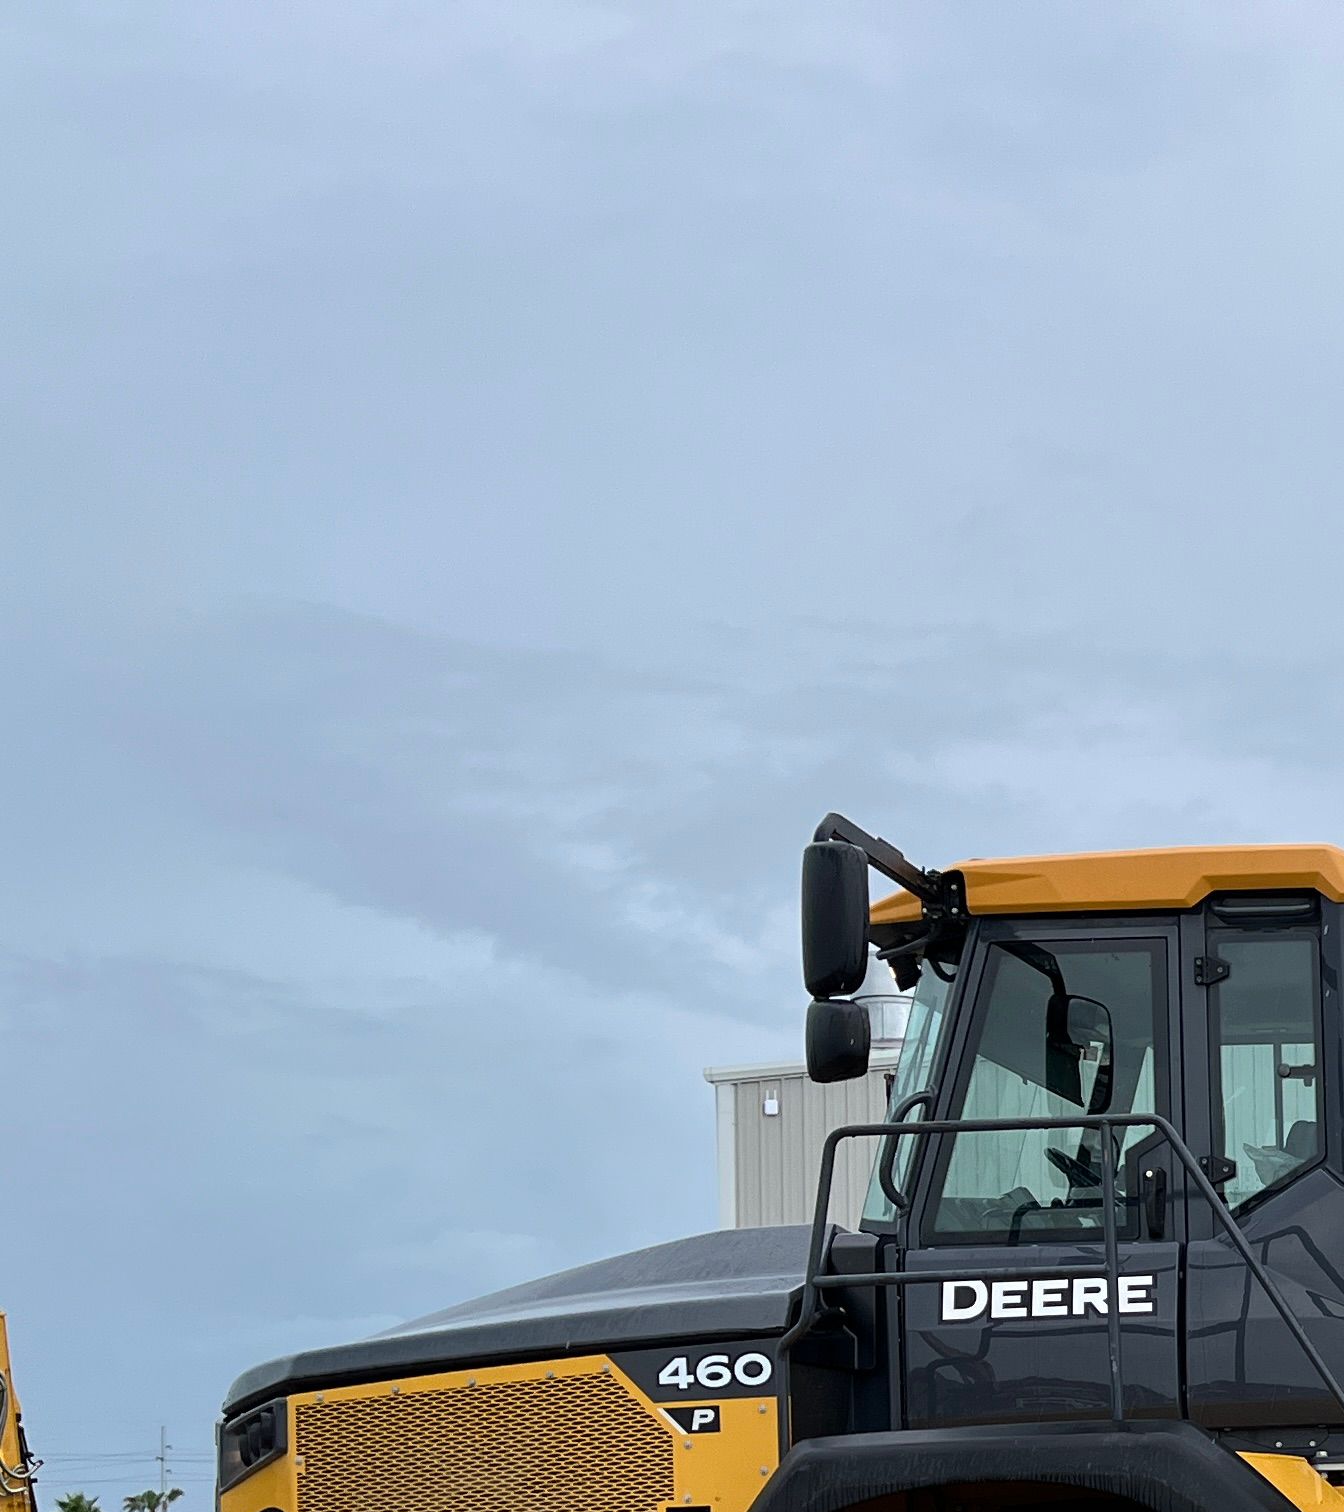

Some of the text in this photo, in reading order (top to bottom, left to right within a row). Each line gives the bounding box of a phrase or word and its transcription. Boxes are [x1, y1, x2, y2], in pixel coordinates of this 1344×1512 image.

[942, 1275, 1153, 1321] DEERE
[658, 1353, 772, 1390] 460
[691, 1408, 715, 1431] P
